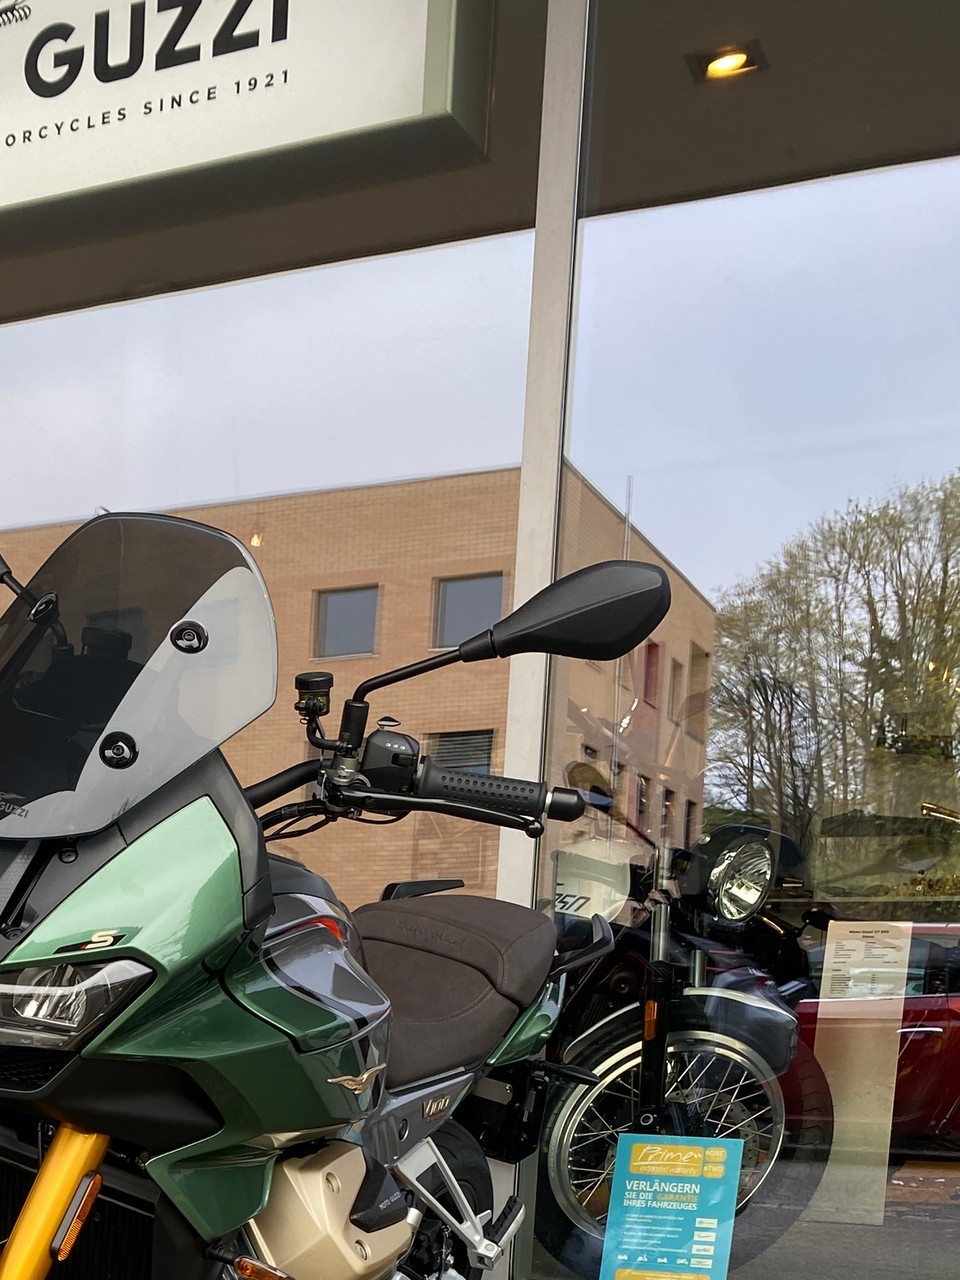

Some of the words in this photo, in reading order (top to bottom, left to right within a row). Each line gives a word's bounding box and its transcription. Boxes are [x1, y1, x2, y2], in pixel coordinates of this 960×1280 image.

[23, 0, 289, 99] GUZZI
[142, 86, 218, 116] SINCE
[233, 69, 290, 96] 1921
[84, 929, 118, 950] S
[638, 1145, 694, 1162] Prime
[624, 1191, 637, 1199] SIE
[639, 1192, 653, 1200] DIE
[625, 1179, 701, 1195] VERLÄNGERN
[623, 1199, 646, 1207] IHRES
[646, 1200, 698, 1211] FAHRZEUGES
